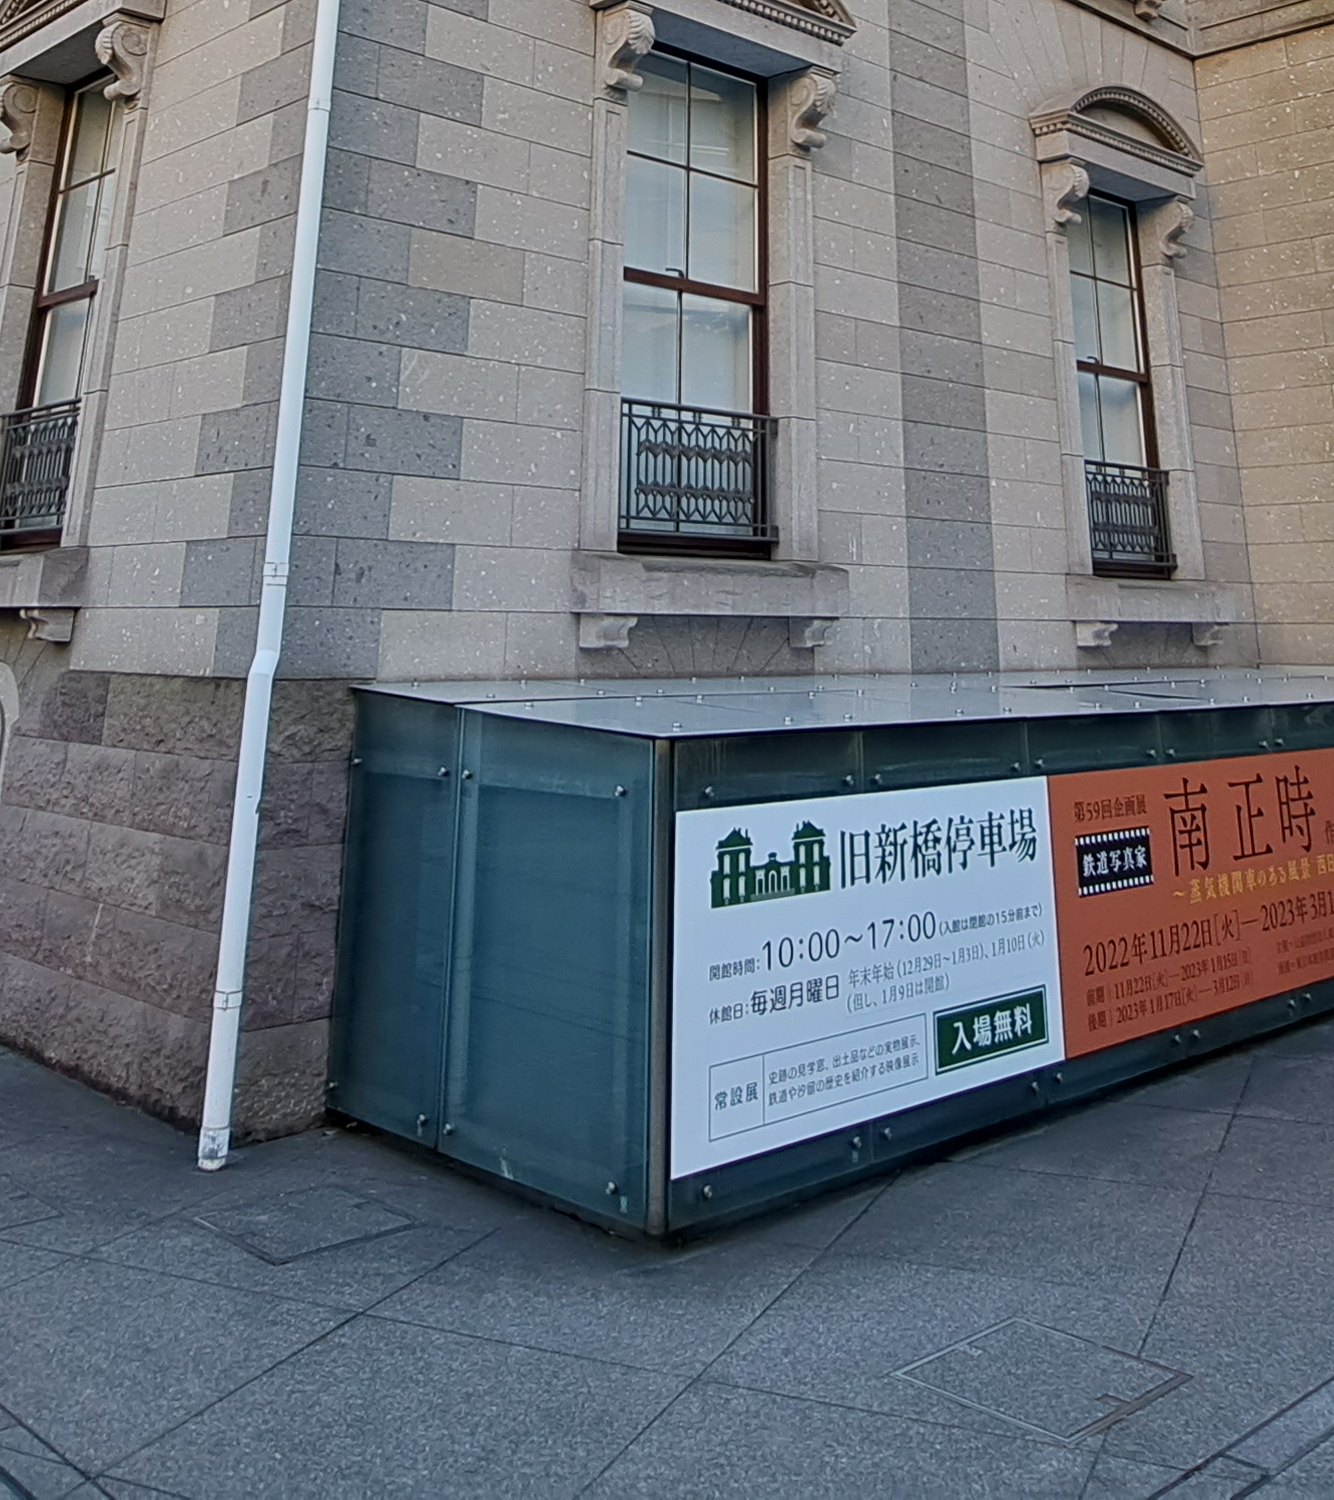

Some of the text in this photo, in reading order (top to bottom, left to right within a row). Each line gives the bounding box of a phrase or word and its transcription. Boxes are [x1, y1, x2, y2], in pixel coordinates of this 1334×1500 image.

[1074, 794, 1147, 823] 第59回企画展
[1163, 765, 1316, 877] 南正時
[840, 807, 1038, 889] 旧新橋停車場
[1082, 845, 1147, 877] 鉄道写真家
[751, 975, 840, 1016] 毎週月曜日
[952, 1003, 1033, 1055] 入場無料
[714, 1081, 759, 1110] 常設展
